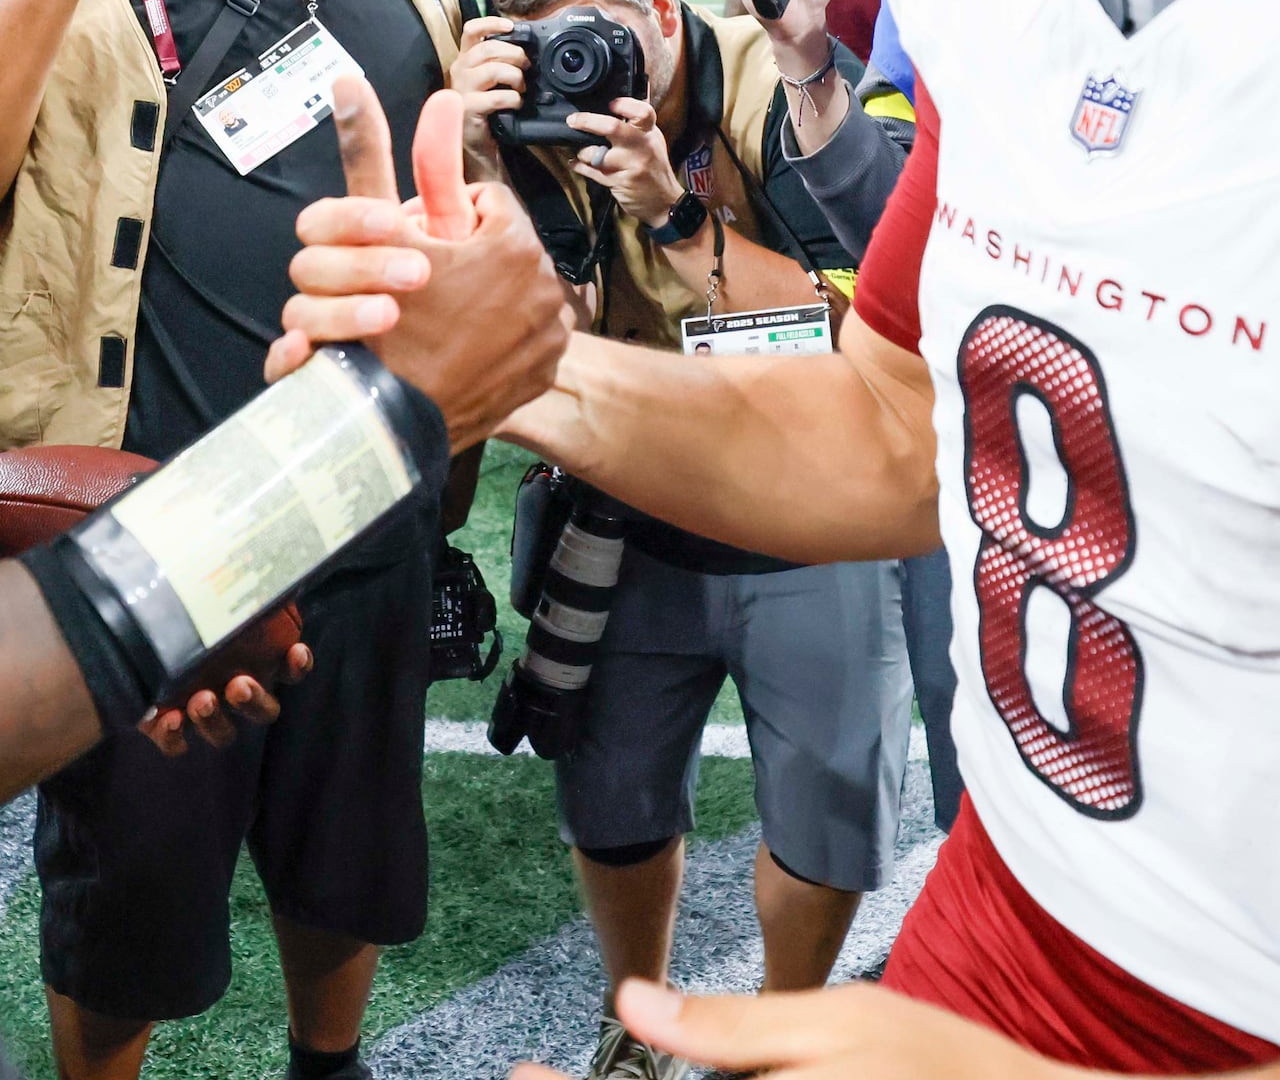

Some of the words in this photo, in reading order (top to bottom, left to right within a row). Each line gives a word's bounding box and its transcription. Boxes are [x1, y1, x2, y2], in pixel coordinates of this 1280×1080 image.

[567, 15, 595, 23] Canon
[1077, 104, 1118, 144] NFL
[937, 202, 1267, 351] WASHINGTON
[726, 317, 754, 329] 2025
[755, 313, 799, 327] SEASON
[957, 304, 1145, 821] 8
